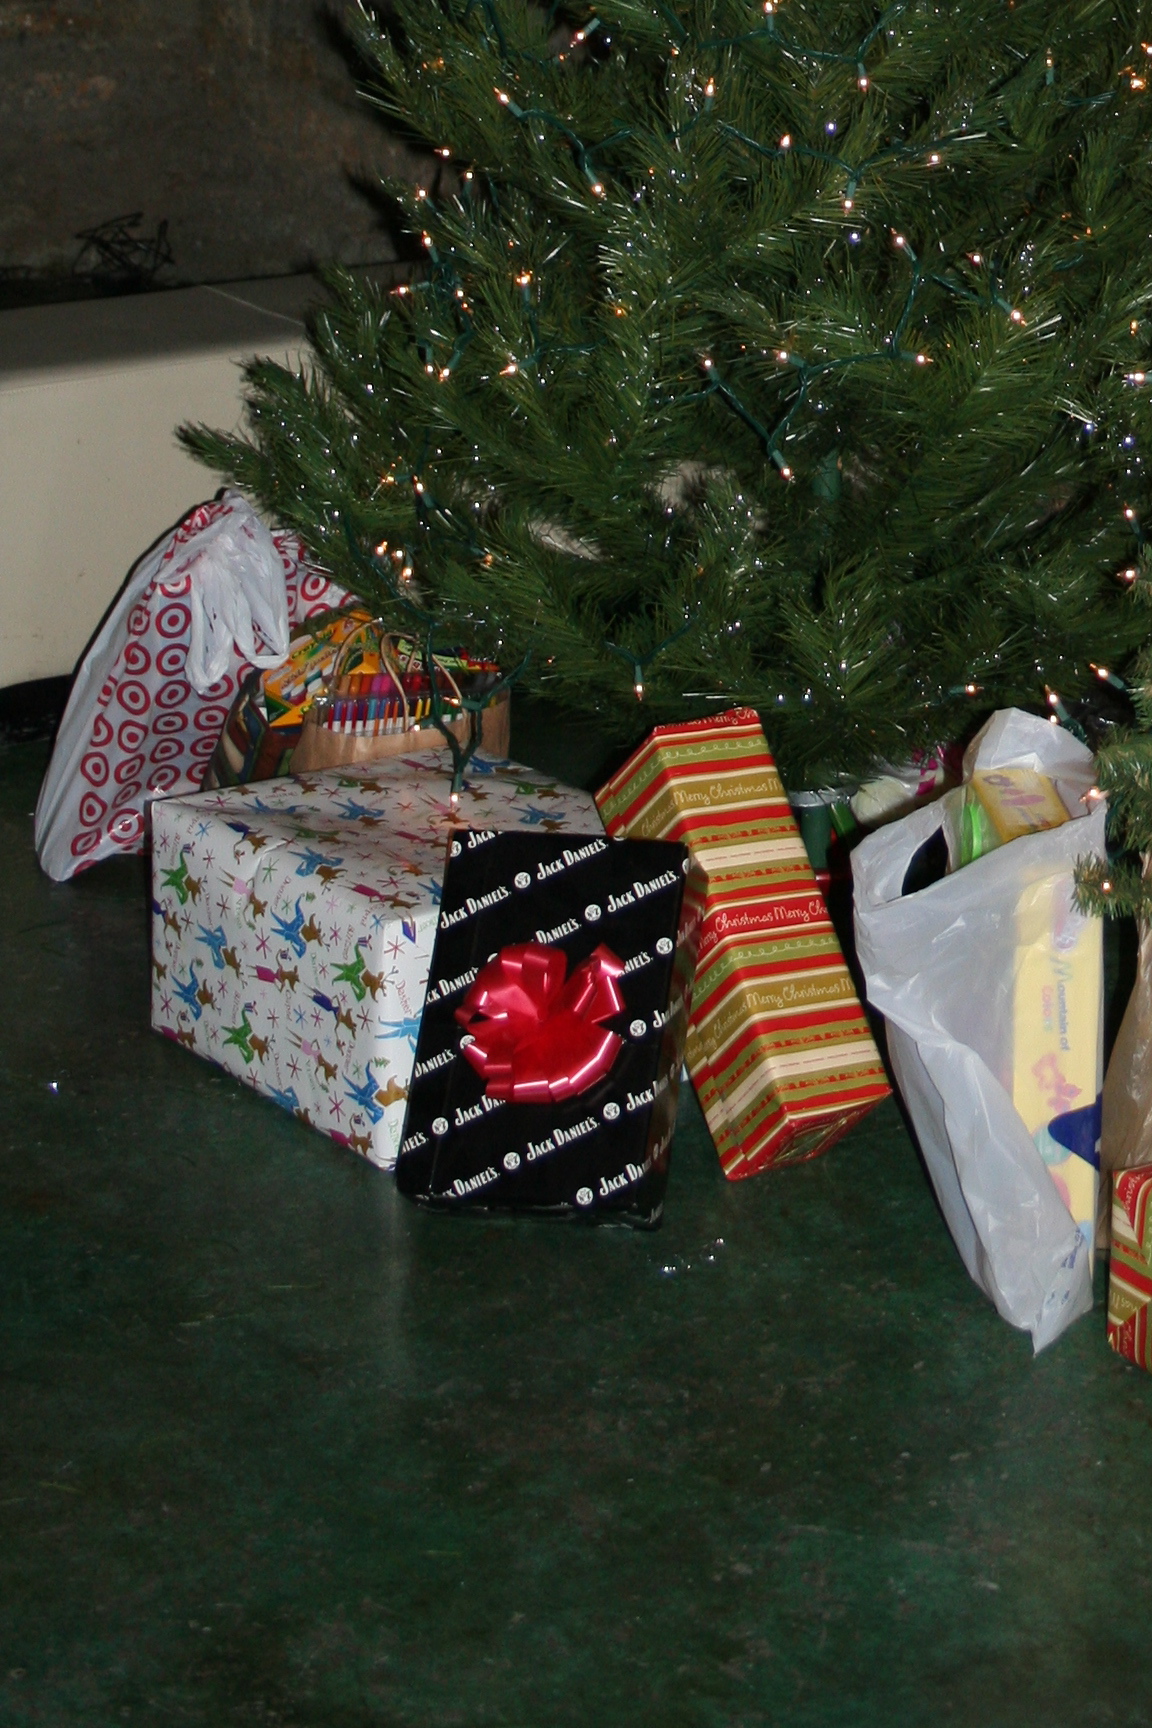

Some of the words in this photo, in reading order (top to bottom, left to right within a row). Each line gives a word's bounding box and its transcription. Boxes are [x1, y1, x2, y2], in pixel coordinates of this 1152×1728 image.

[673, 789, 711, 806] Merry
[709, 779, 768, 800] Christmas
[440, 907, 468, 930] JACK
[536, 860, 566, 881] JACK
[607, 891, 637, 913] JACK
[714, 910, 774, 934] Christmas
[772, 904, 811, 923] Merry
[746, 992, 784, 1009] Merry
[782, 982, 841, 1001] Christmas
[454, 1102, 484, 1127] JACK
[526, 1136, 554, 1162] JACK
[626, 1086, 655, 1112] JACK
[599, 1173, 629, 1197] JACK
